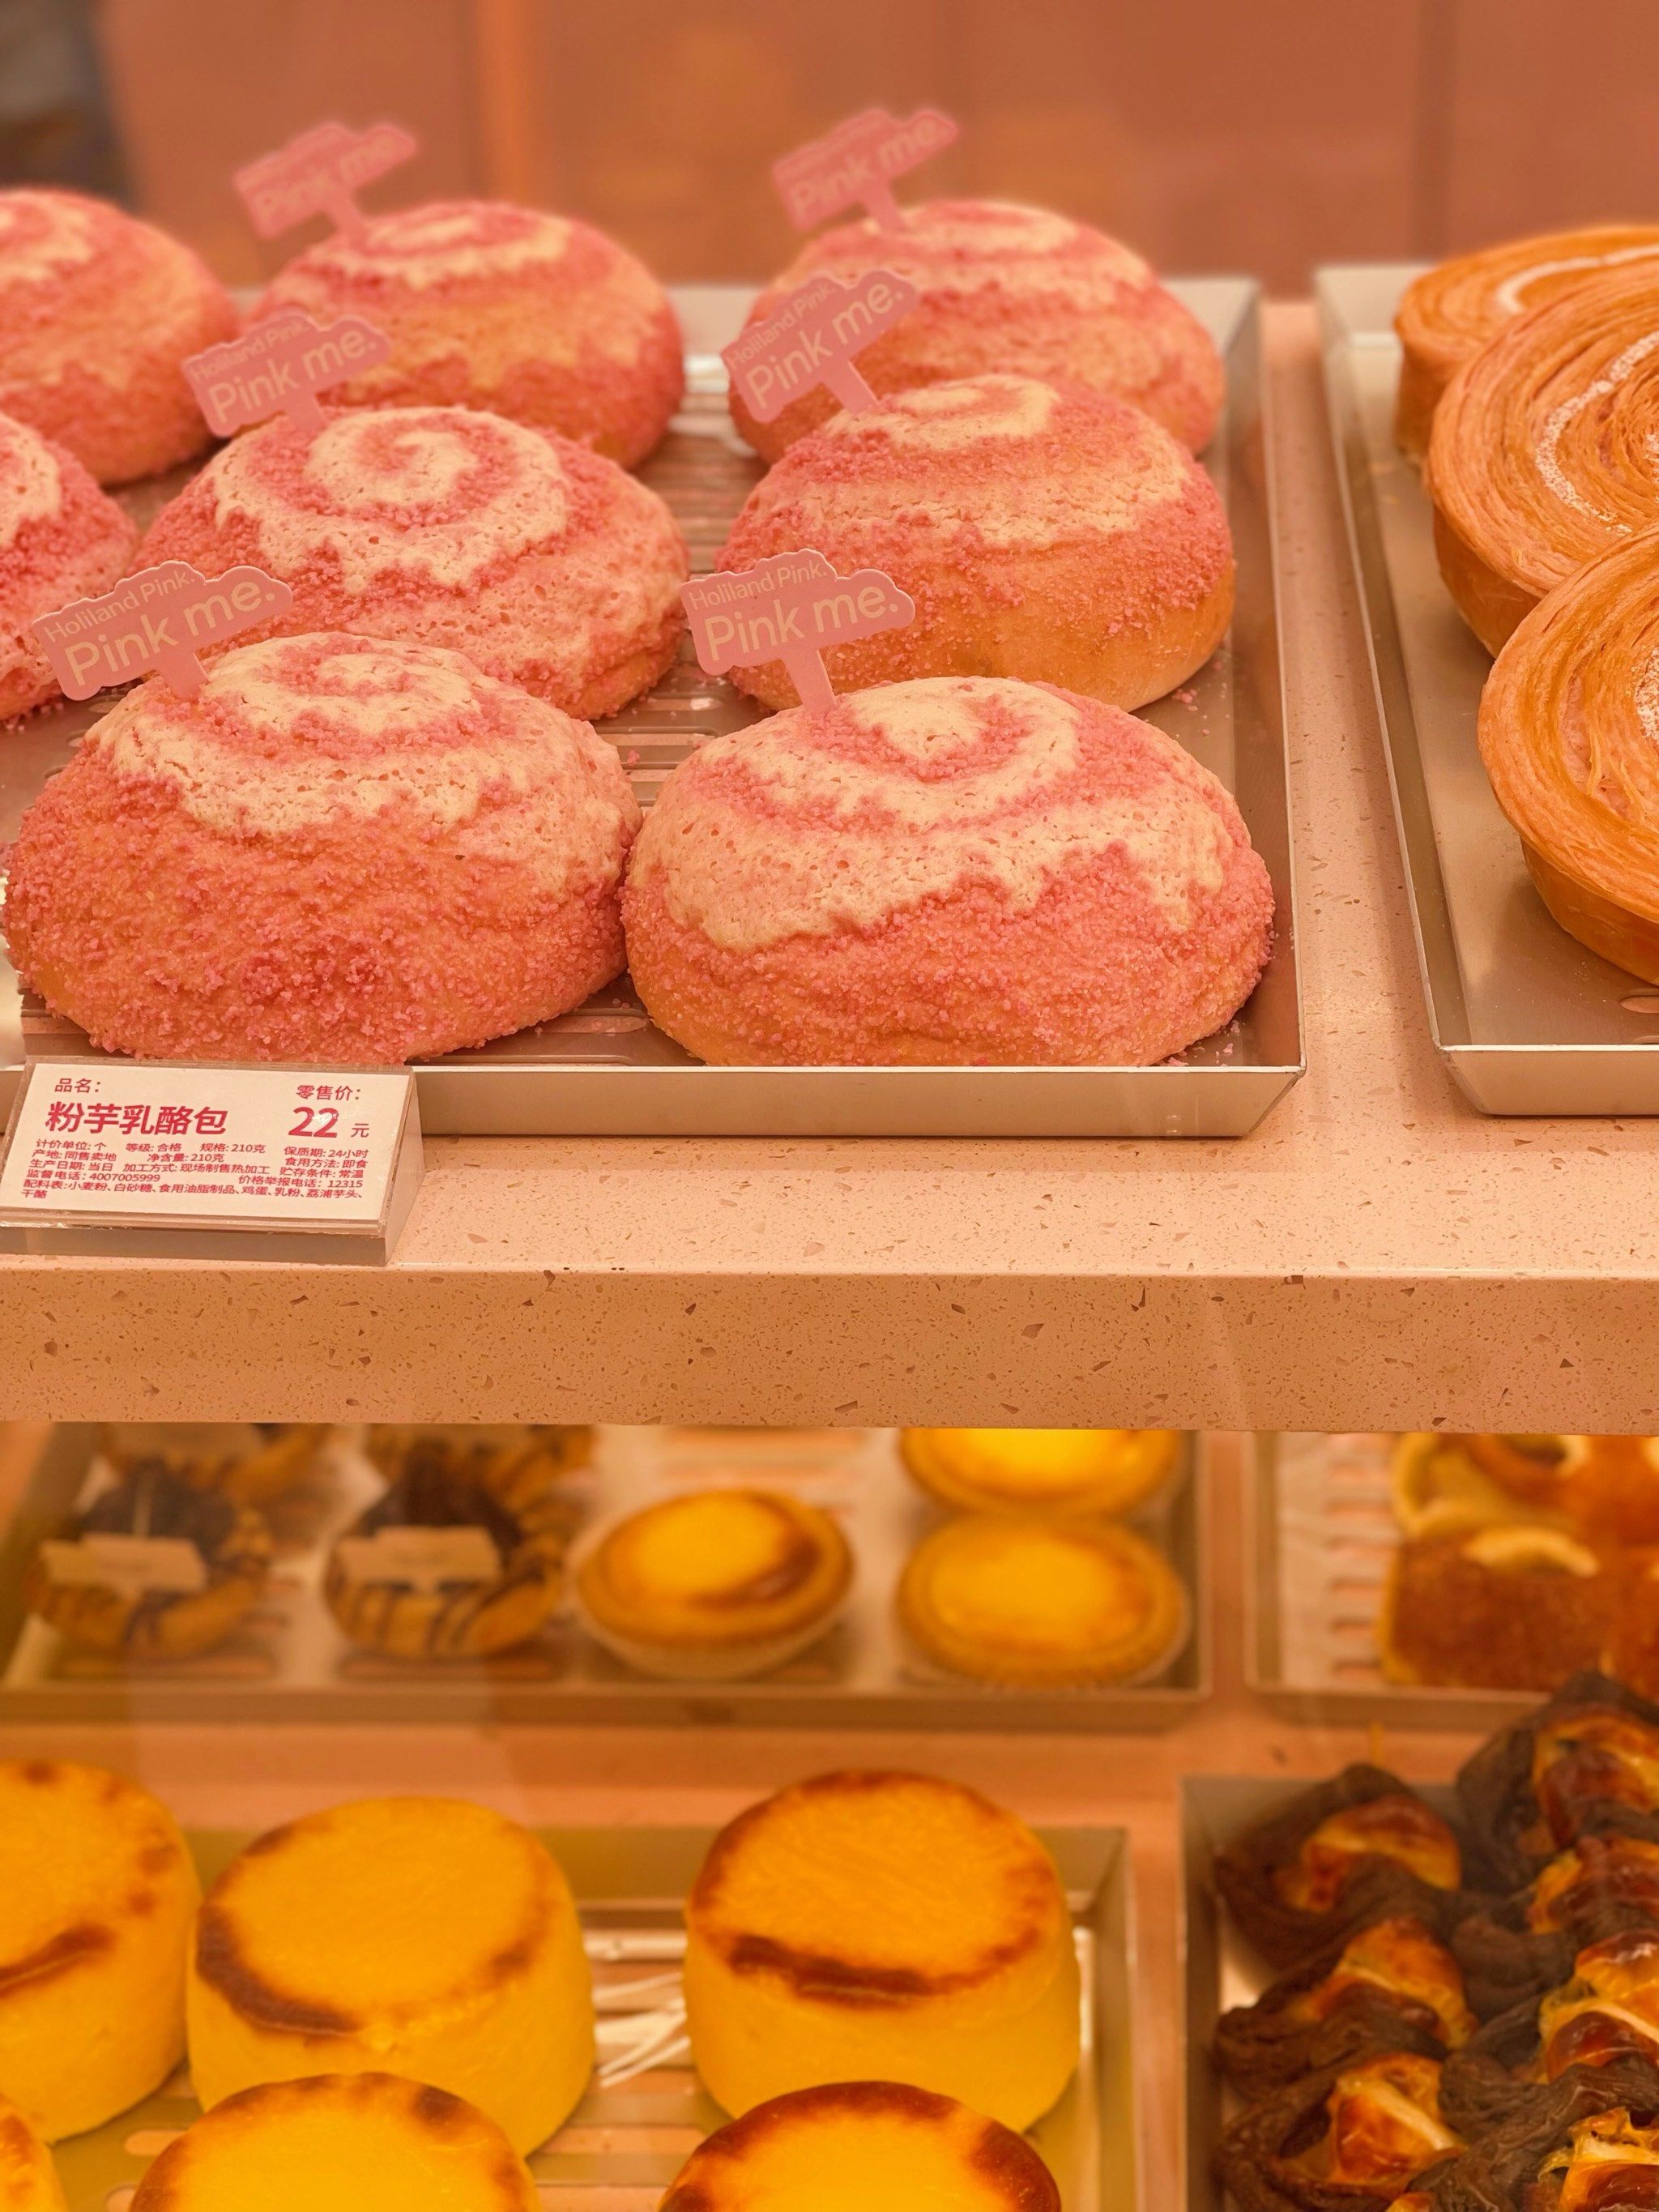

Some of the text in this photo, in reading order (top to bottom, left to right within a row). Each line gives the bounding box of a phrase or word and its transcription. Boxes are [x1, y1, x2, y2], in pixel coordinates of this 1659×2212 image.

[729, 285, 837, 370] Holiland Pink.
[745, 283, 905, 409] Pink me.
[207, 330, 377, 424] Pink me.
[43, 569, 196, 643] Holiland Pink.
[689, 559, 828, 610] Holiland Pink.
[64, 581, 275, 686] Pink me.
[704, 586, 898, 662] Pink me.
[45, 1101, 228, 1135] 粉芋乳酪包
[54, 1078, 101, 1094] 品名：
[288, 1106, 370, 1138] 22 元
[296, 1084, 361, 1101] 零售价：
